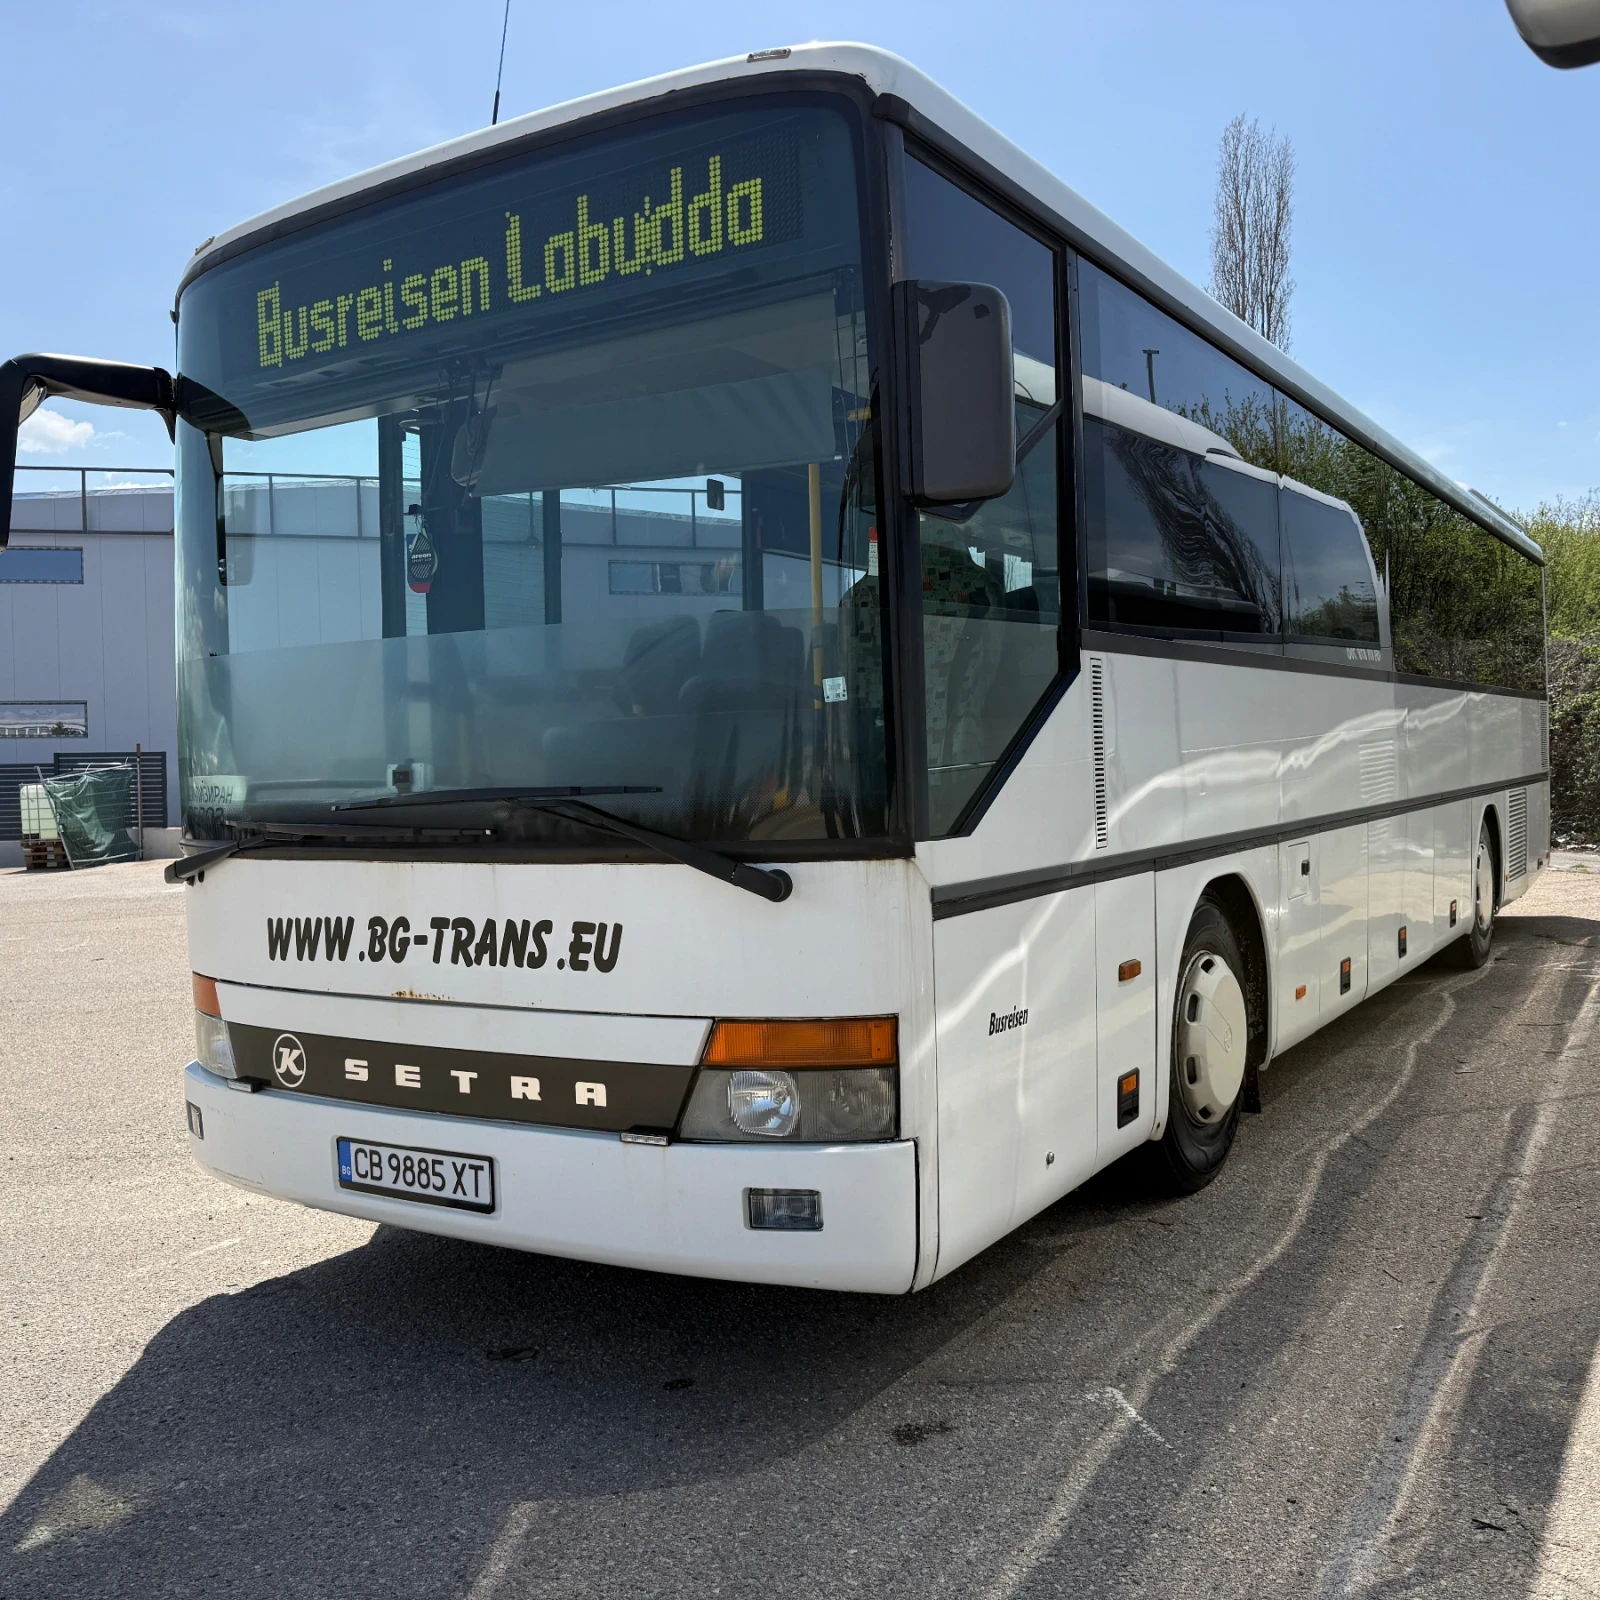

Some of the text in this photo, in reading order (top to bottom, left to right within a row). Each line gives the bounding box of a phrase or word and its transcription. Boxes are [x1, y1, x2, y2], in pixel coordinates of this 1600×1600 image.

[988, 1004, 1029, 1037] Busreisen
[344, 1057, 608, 1108] SETRA
[341, 1147, 485, 1198] BG CB 9885 XT
